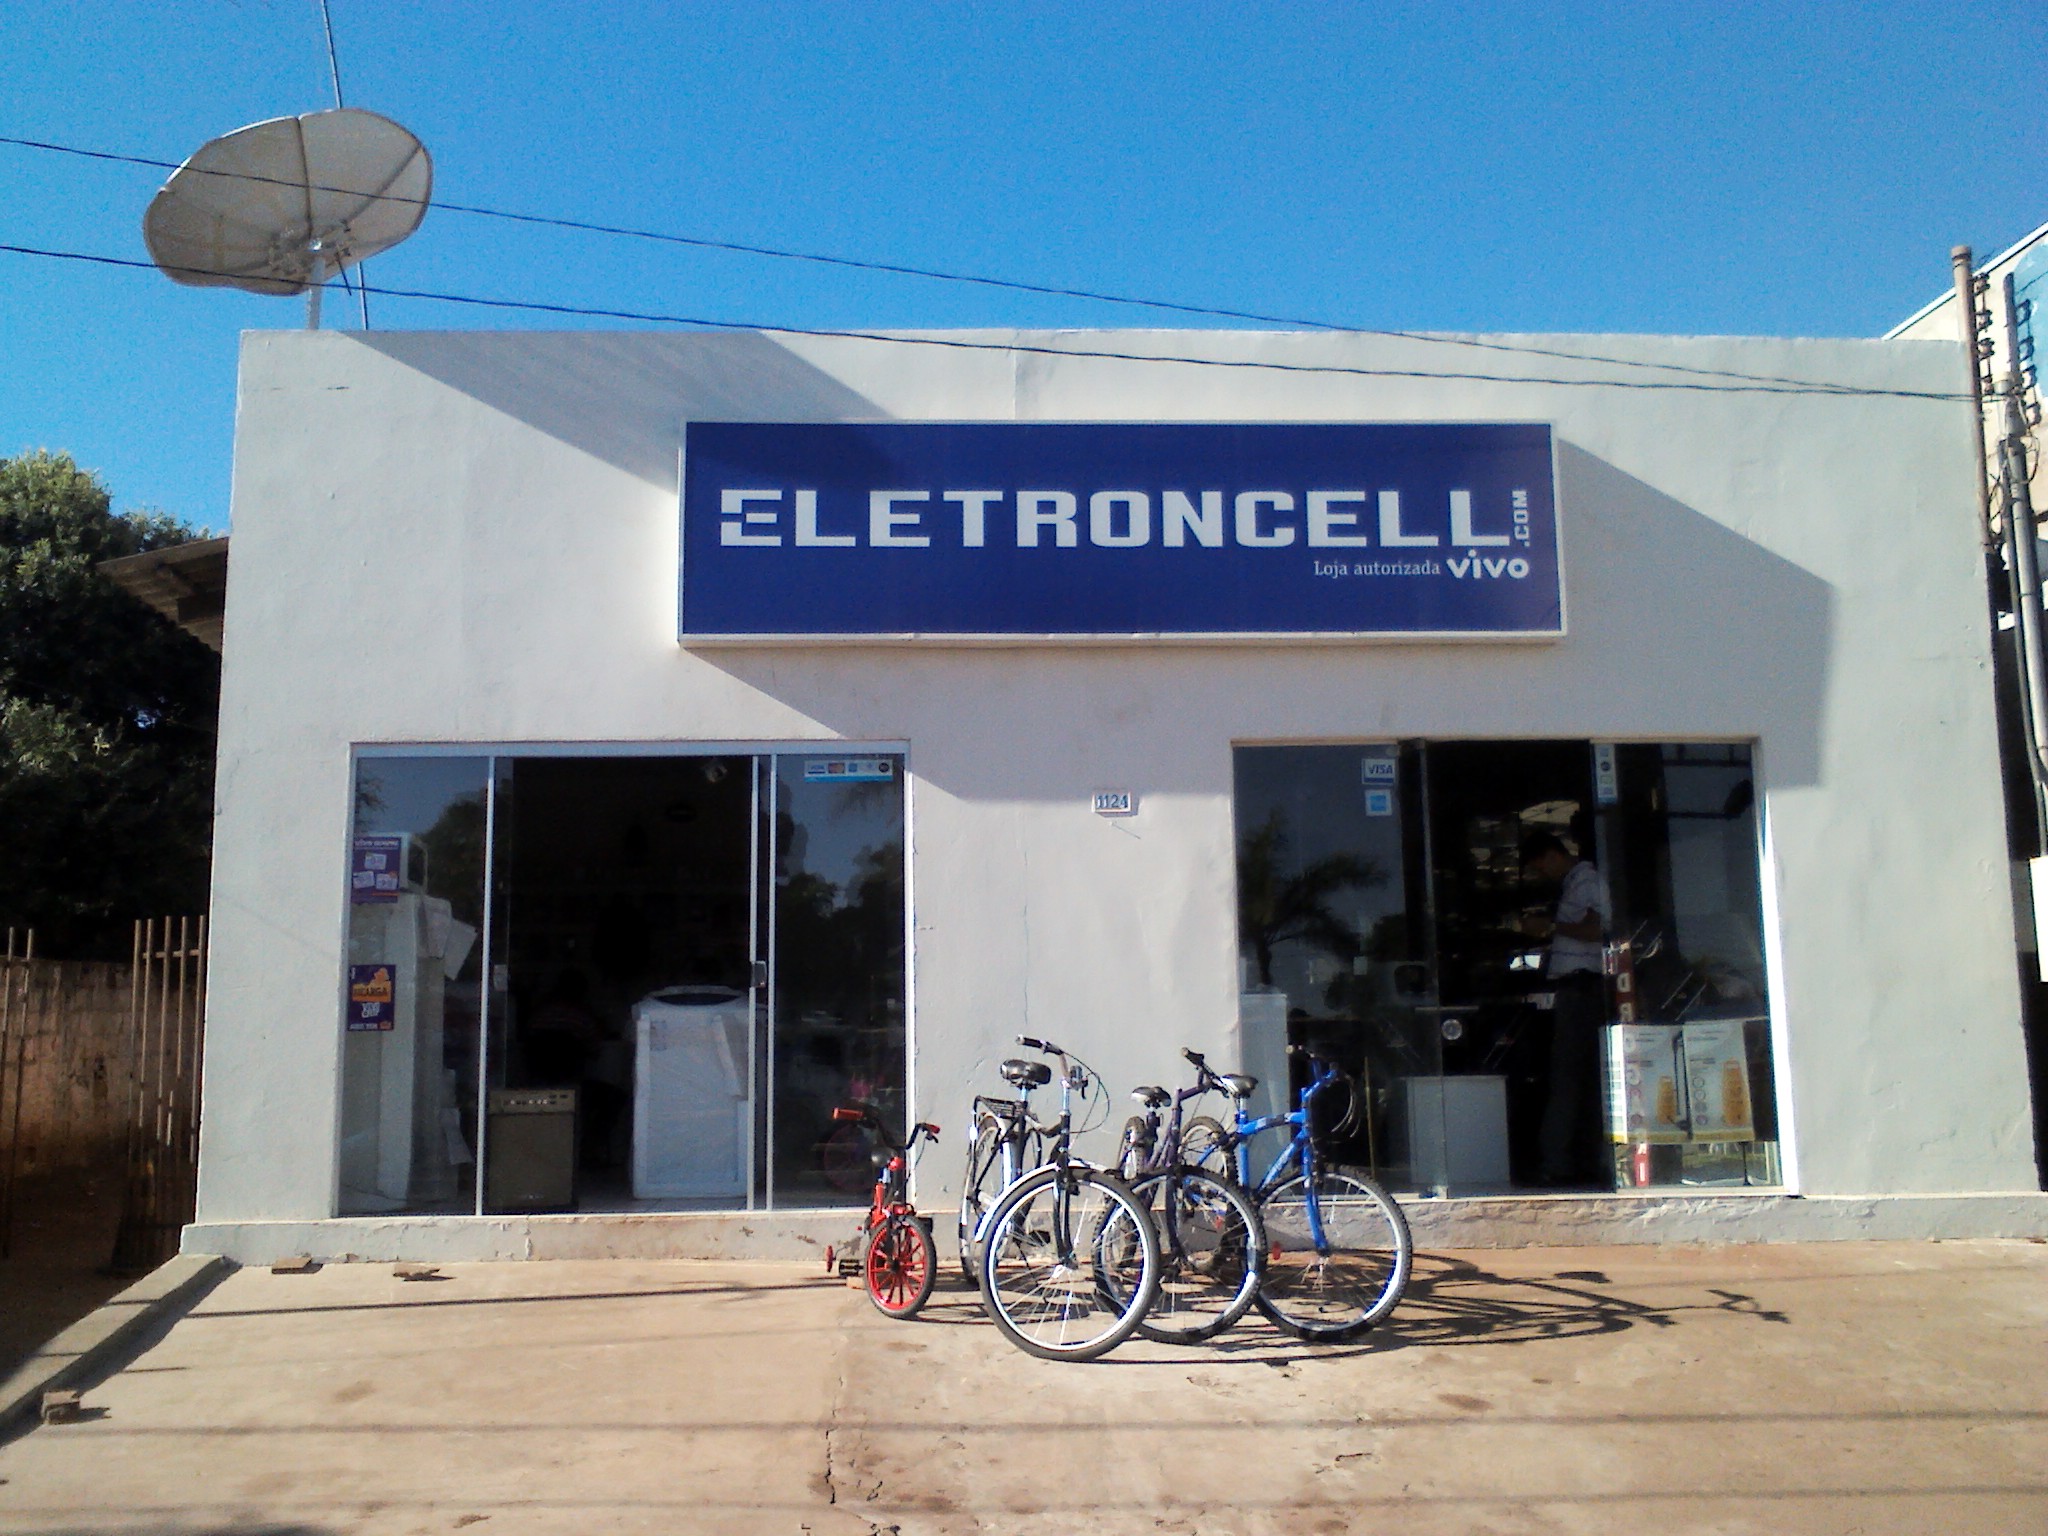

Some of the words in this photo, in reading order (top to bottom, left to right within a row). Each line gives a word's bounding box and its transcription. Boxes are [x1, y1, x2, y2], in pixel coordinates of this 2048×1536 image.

[719, 489, 1512, 548] ELETRONCELL
[1511, 489, 1530, 548] .COM
[1313, 560, 1348, 579] Loja
[1353, 560, 1441, 577] autorizada
[1446, 549, 1530, 579] vivo
[1368, 763, 1393, 774] VISA
[1096, 793, 1128, 809] 1124
